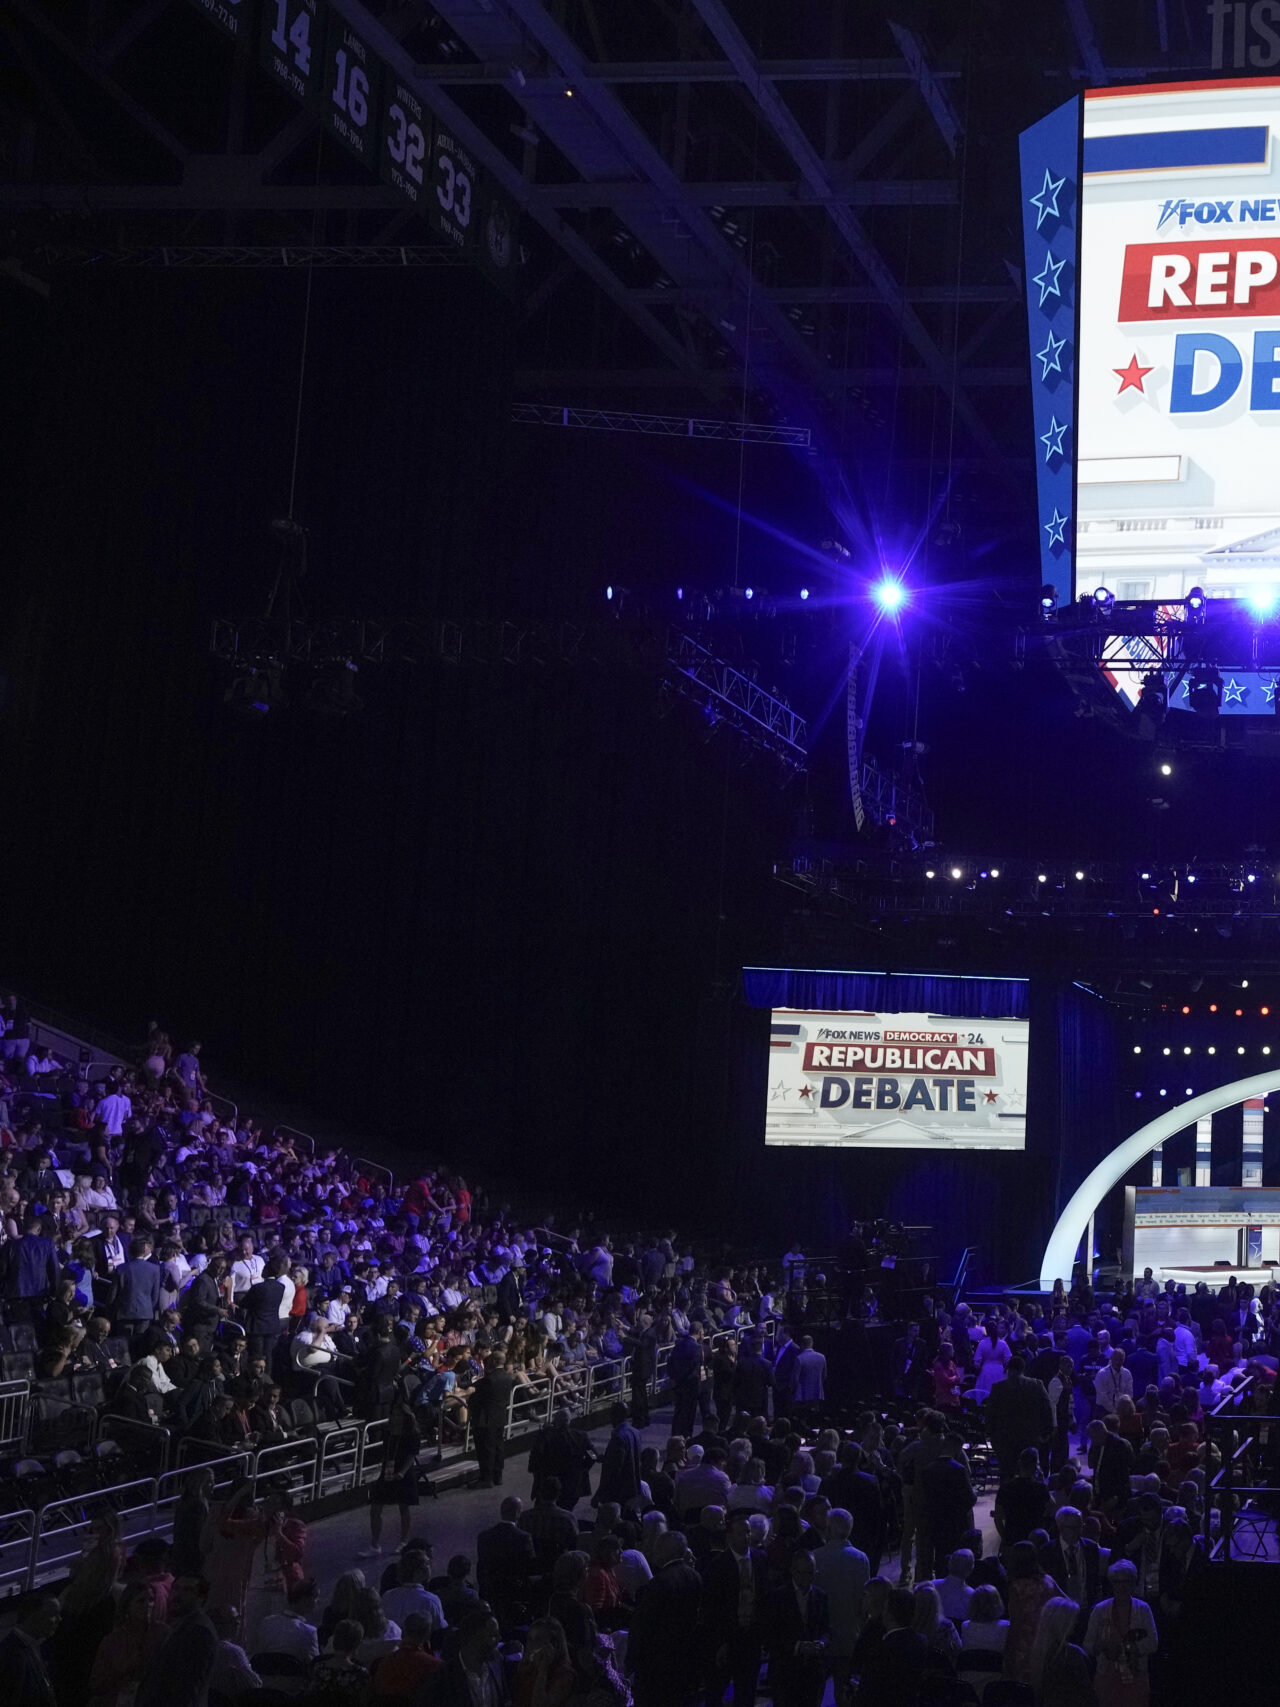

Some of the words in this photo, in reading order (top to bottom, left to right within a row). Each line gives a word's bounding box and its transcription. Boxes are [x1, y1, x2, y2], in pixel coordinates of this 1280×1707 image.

[271, 0, 312, 76] 14
[343, 31, 367, 64] LANIER
[332, 48, 369, 127] 16
[396, 85, 423, 121] WINTERS
[387, 103, 425, 185] 32
[437, 155, 472, 228] 33
[1179, 200, 1234, 225] FOX
[825, 1030, 847, 1040] FOX
[849, 1031, 881, 1041] NEWS
[886, 1032, 955, 1043] DEMOCRACY
[967, 1033, 984, 1045] 24
[812, 1046, 986, 1071] REPUBLICAN
[820, 1076, 976, 1111] DEBATE
